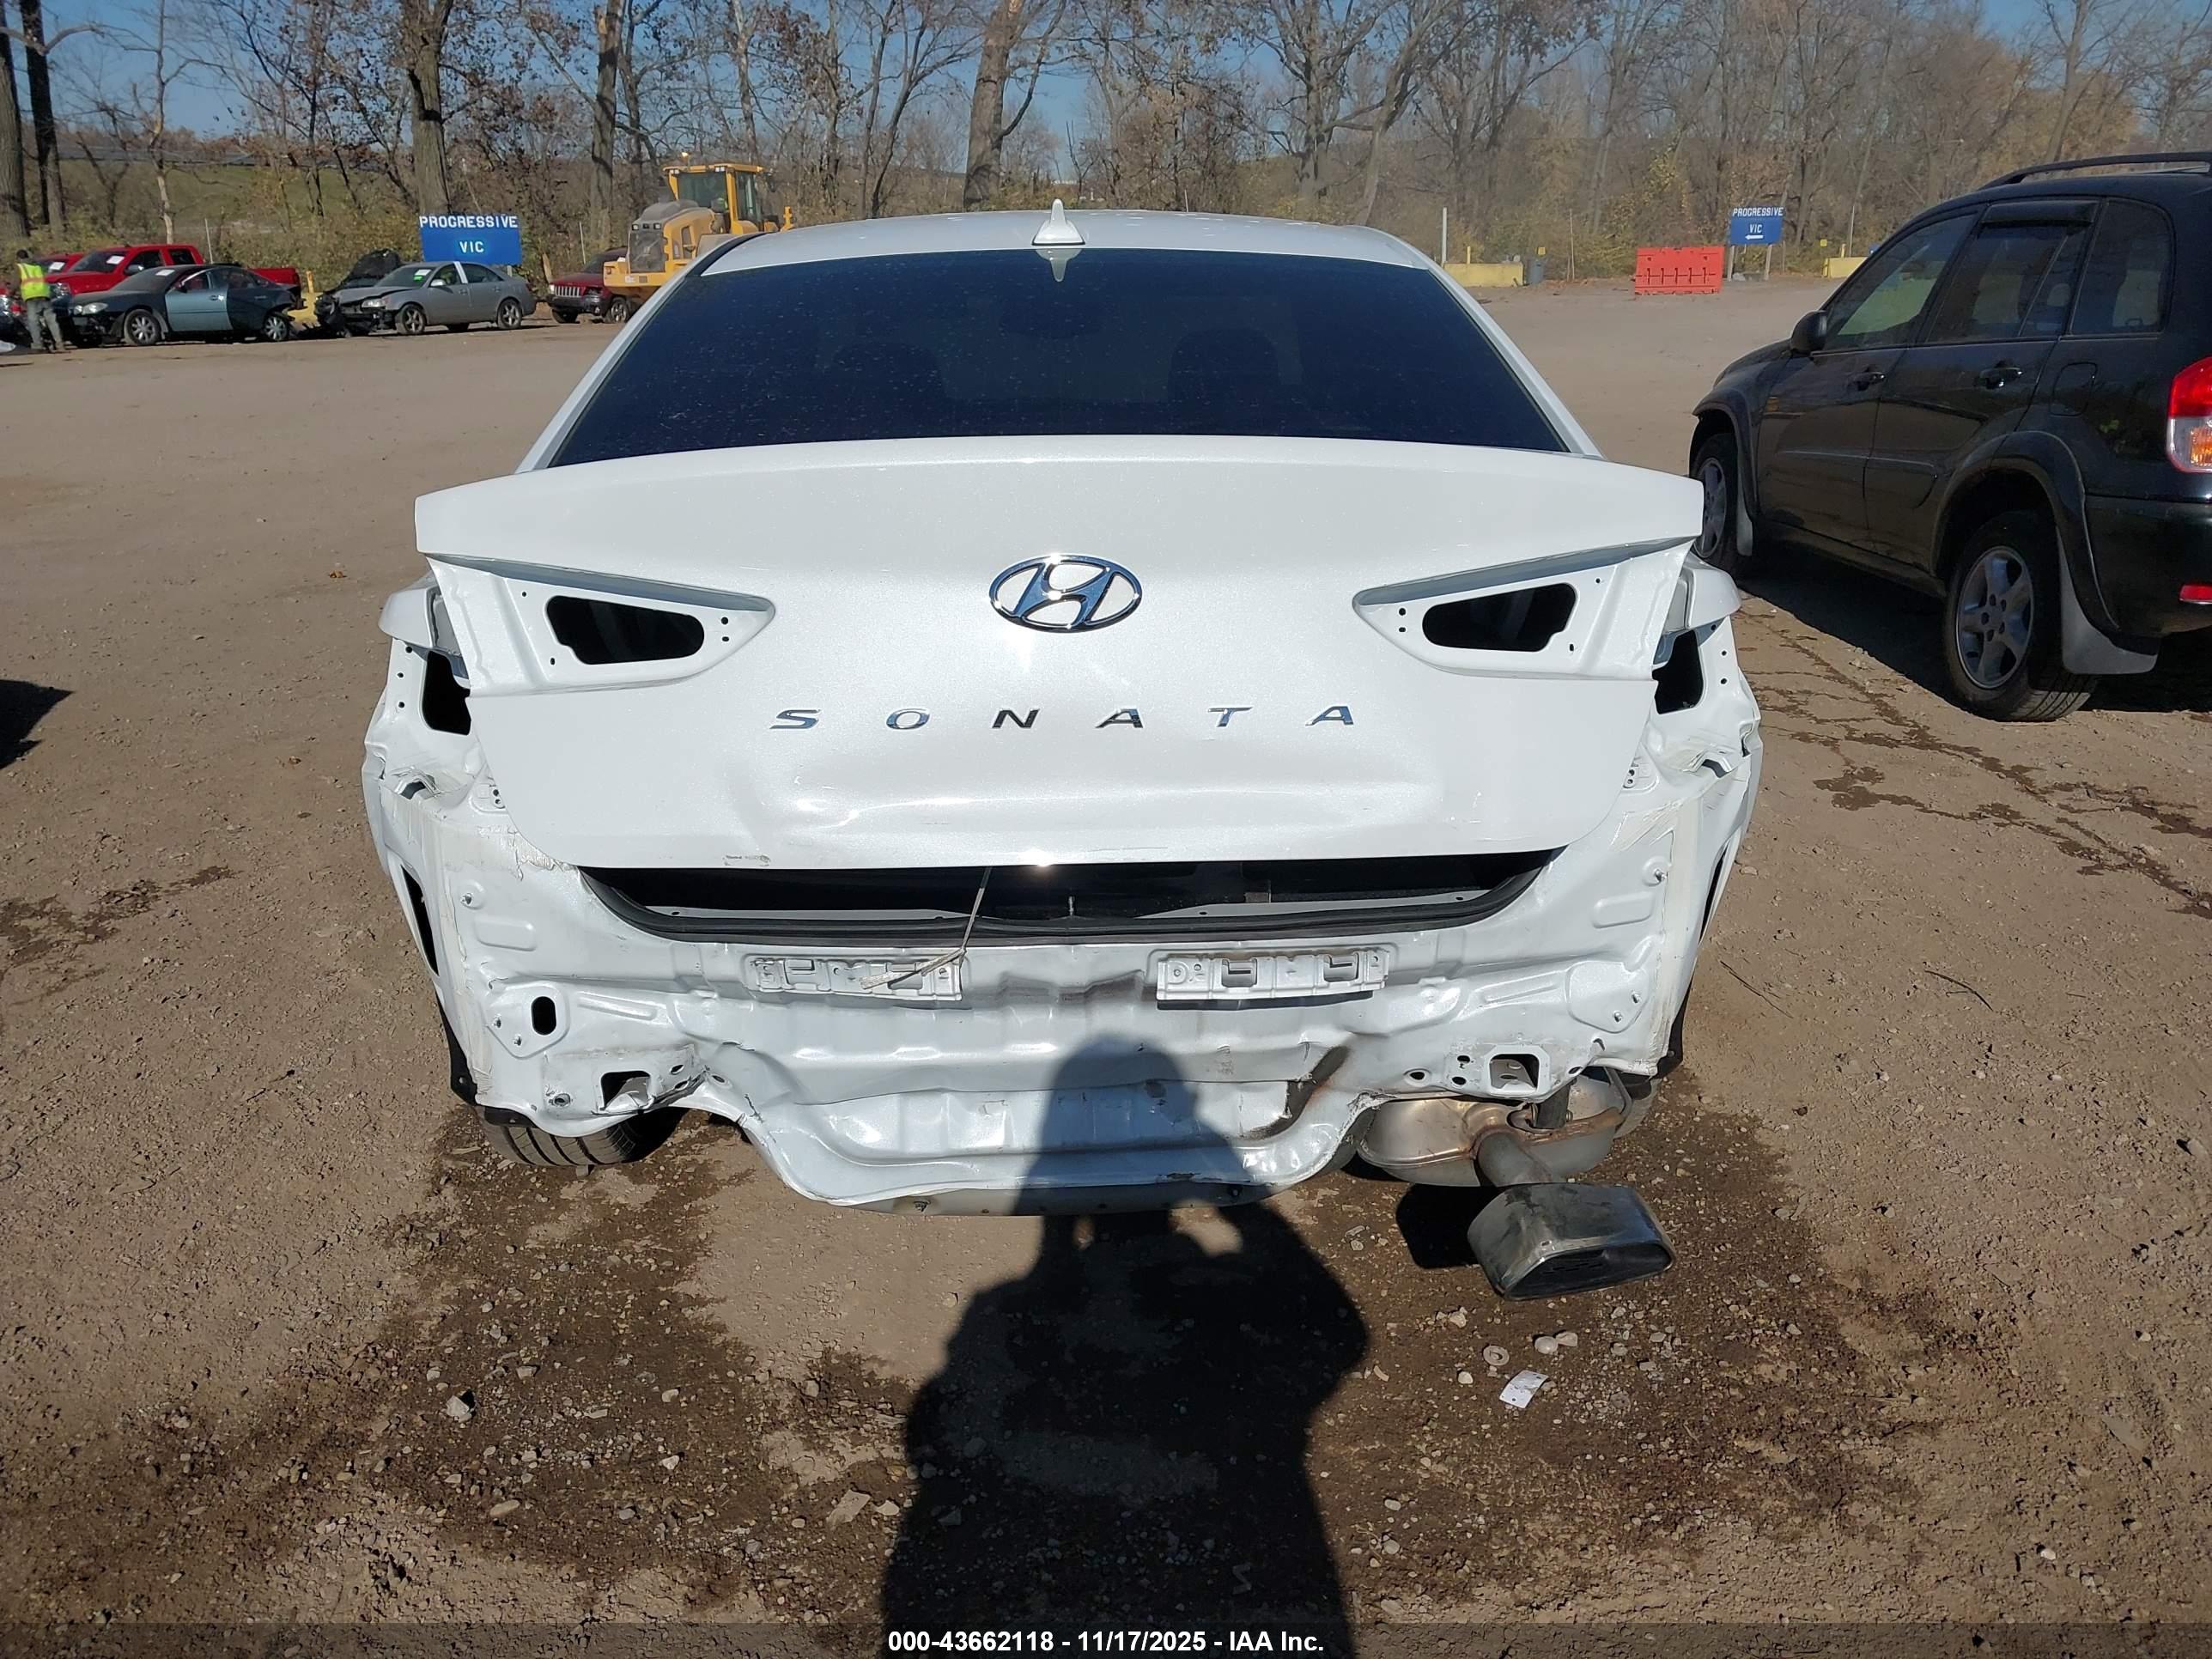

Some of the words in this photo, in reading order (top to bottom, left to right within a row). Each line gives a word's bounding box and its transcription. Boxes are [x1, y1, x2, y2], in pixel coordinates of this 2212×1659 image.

[1732, 207, 1784, 217] PROGRESSIVE
[419, 216, 519, 228] PROGRESSIVE
[1749, 224, 1763, 234] VIC
[459, 240, 485, 253] VIC
[769, 706, 1355, 730] SONATA
